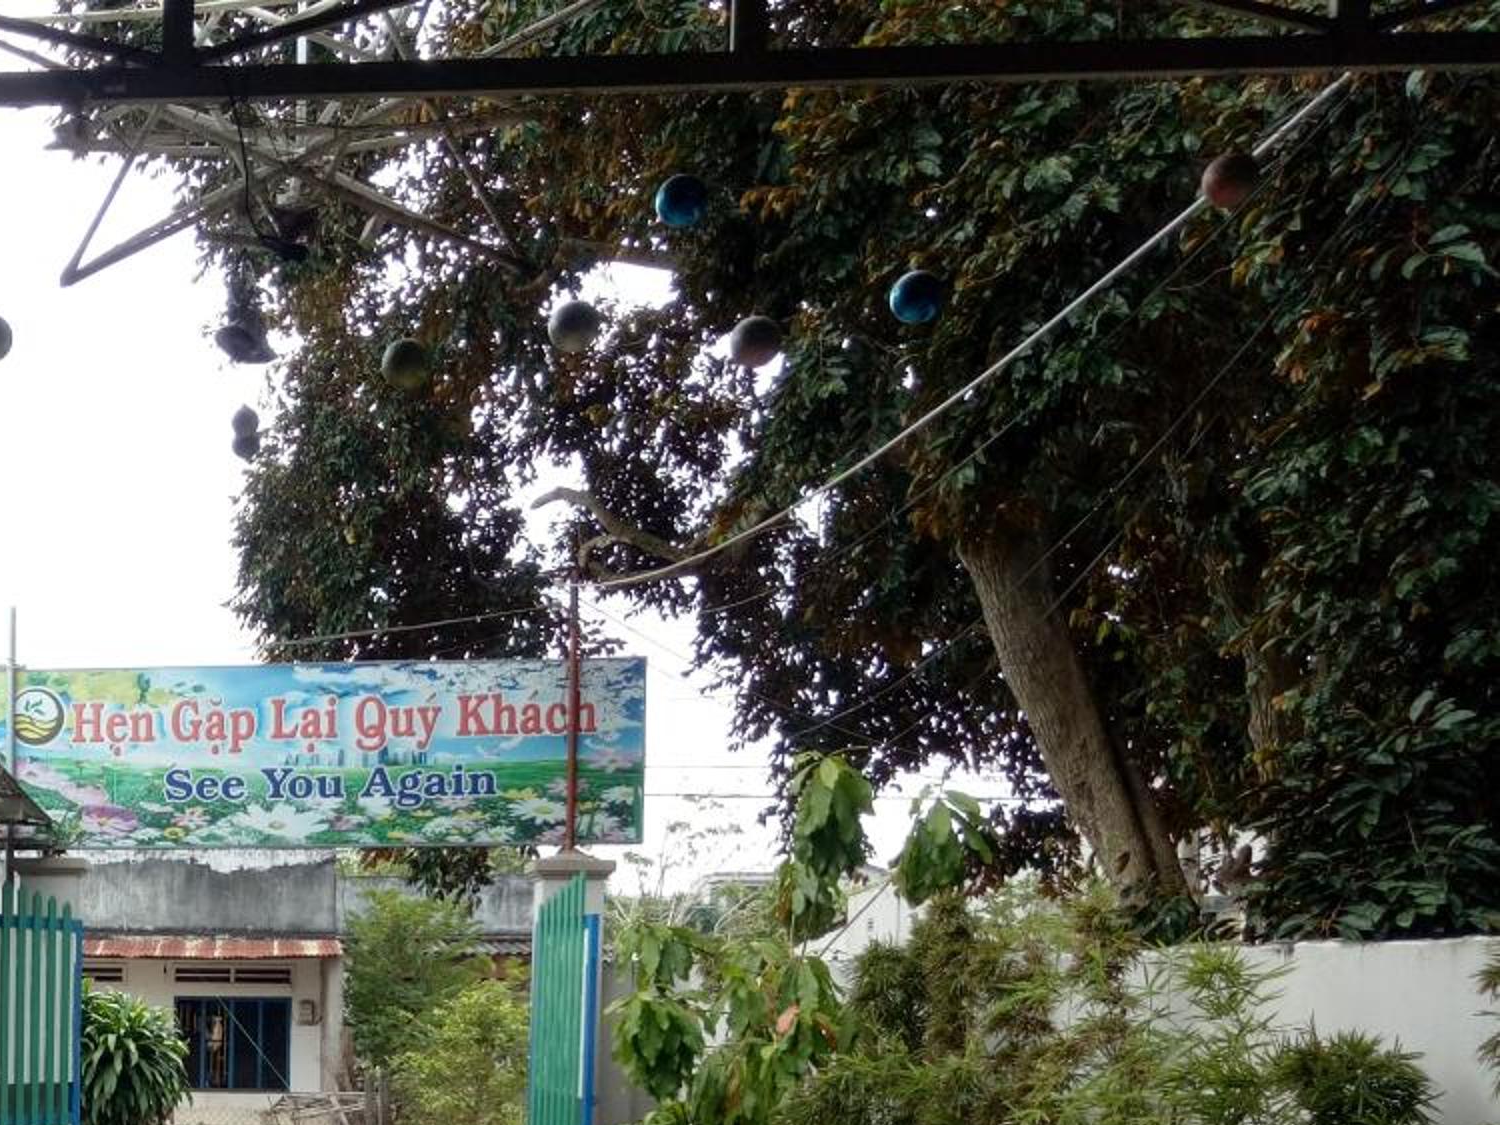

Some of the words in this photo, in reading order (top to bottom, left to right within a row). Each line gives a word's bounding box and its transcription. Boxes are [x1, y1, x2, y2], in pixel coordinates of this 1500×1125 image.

[72, 702, 155, 756] Hẹn
[171, 696, 256, 754] Gặp
[270, 697, 339, 753] Lại
[354, 692, 442, 751] Quý
[165, 769, 245, 800] See
[261, 767, 344, 799] You
[360, 764, 498, 807] Again
